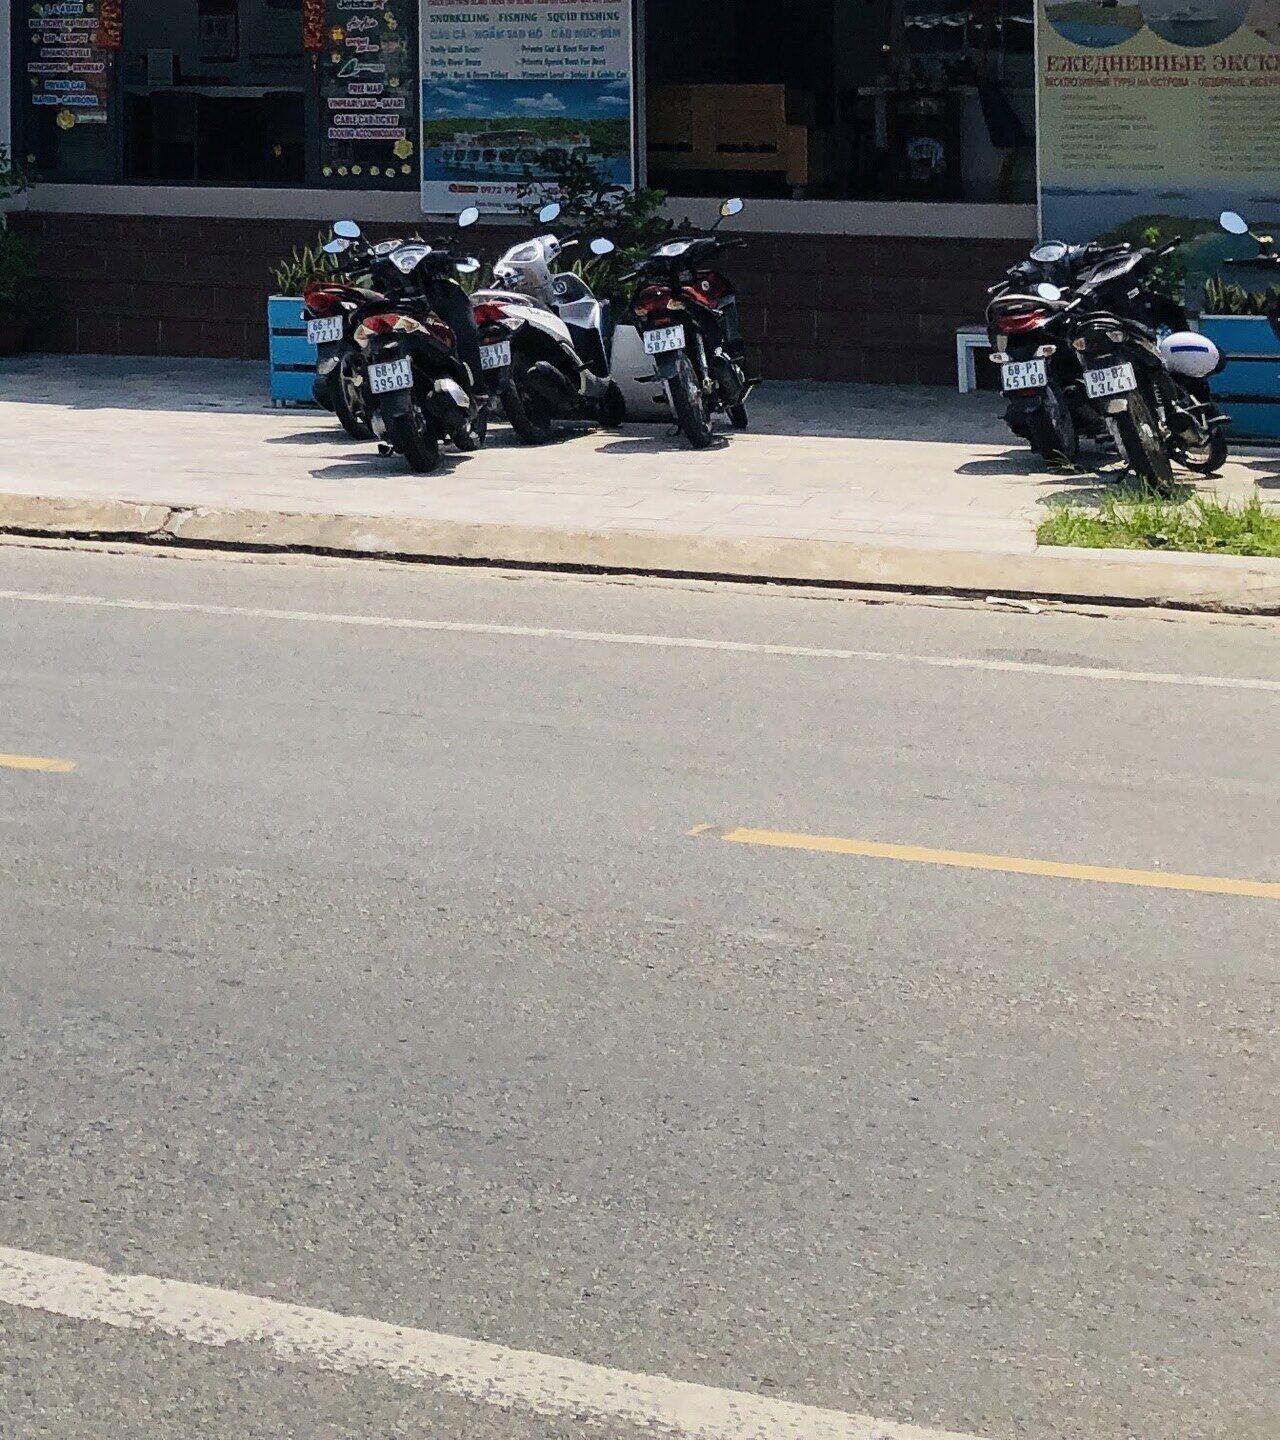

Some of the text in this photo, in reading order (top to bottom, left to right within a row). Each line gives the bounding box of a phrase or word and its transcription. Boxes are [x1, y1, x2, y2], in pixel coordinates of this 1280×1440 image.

[429, 11, 620, 23] SNORKELING FISHING SQUID FISHING
[1046, 54, 1207, 74] ЕЖЕДНЕВНЫЕ
